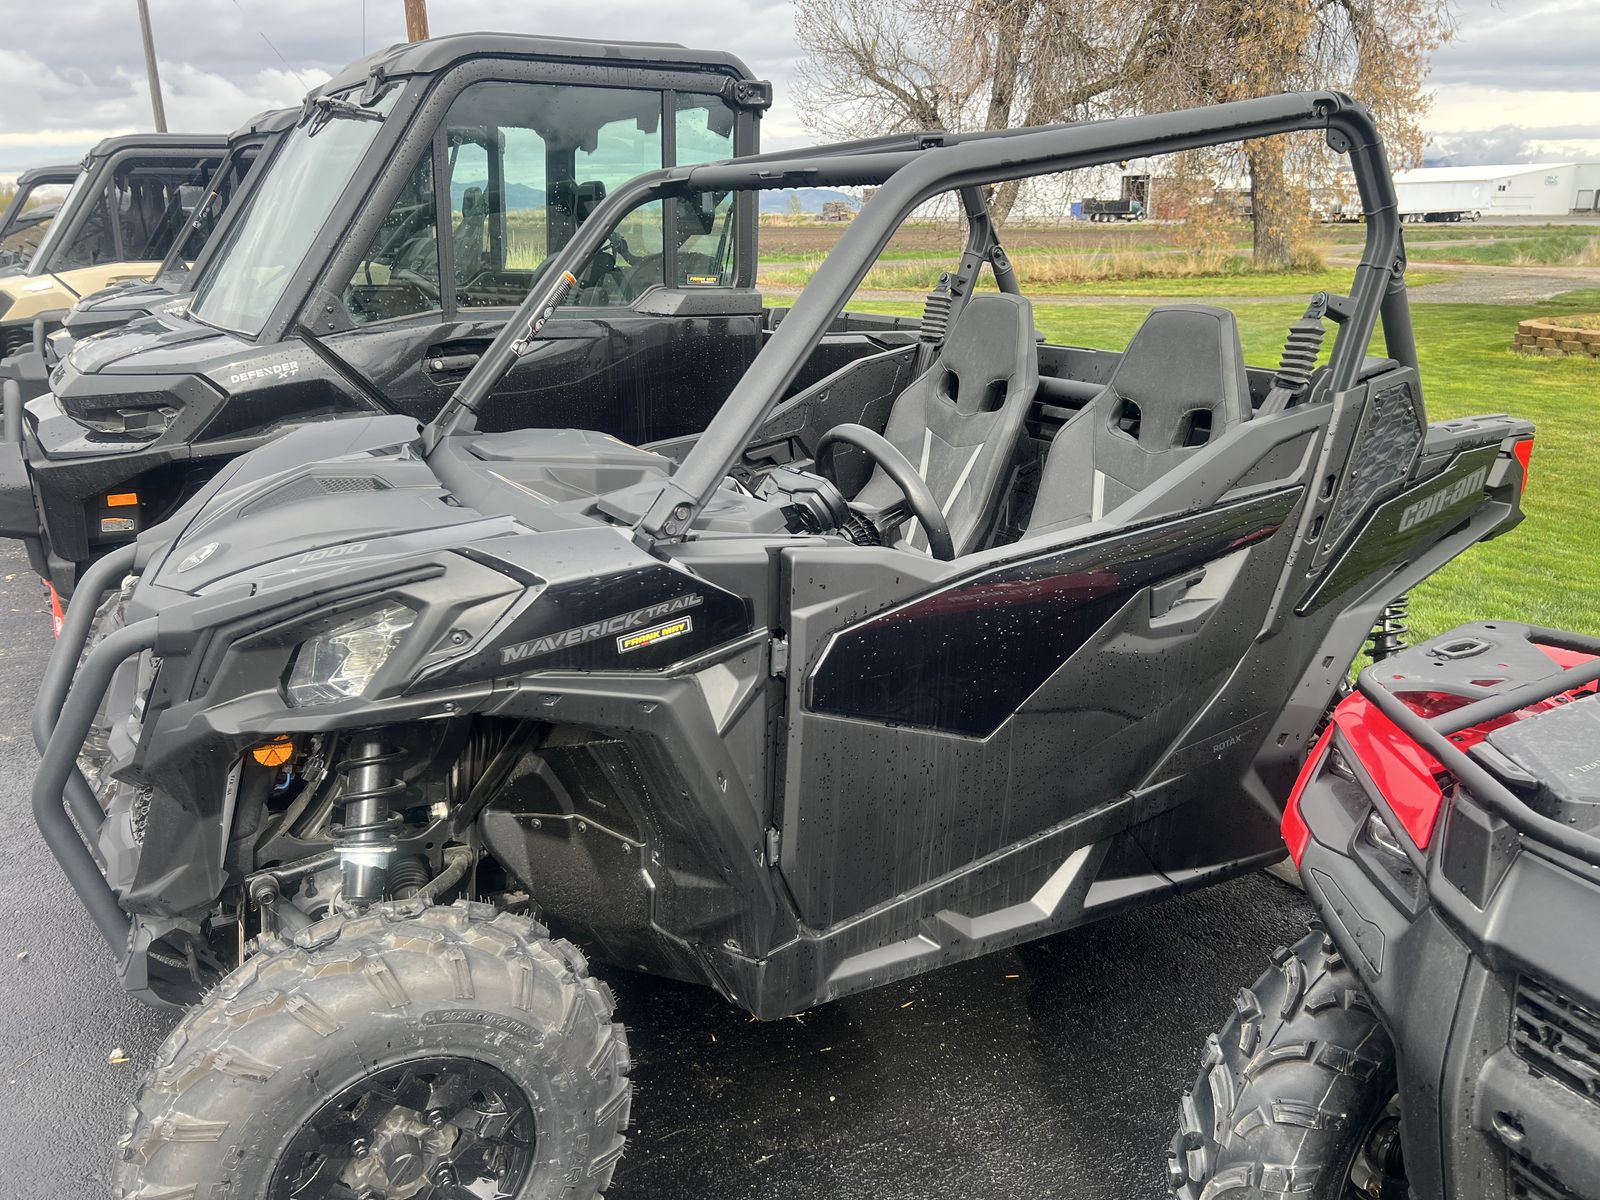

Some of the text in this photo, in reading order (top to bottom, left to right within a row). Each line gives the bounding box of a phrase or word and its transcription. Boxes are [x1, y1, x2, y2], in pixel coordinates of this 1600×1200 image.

[230, 361, 299, 384] DEFENDER
[278, 369, 299, 379] XT
[300, 542, 368, 563] 1000
[502, 593, 704, 664] MAVERICK TRAIL
[624, 631, 661, 648] FRANK
[661, 623, 686, 636] MAY
[1213, 735, 1241, 753] ROTAX
